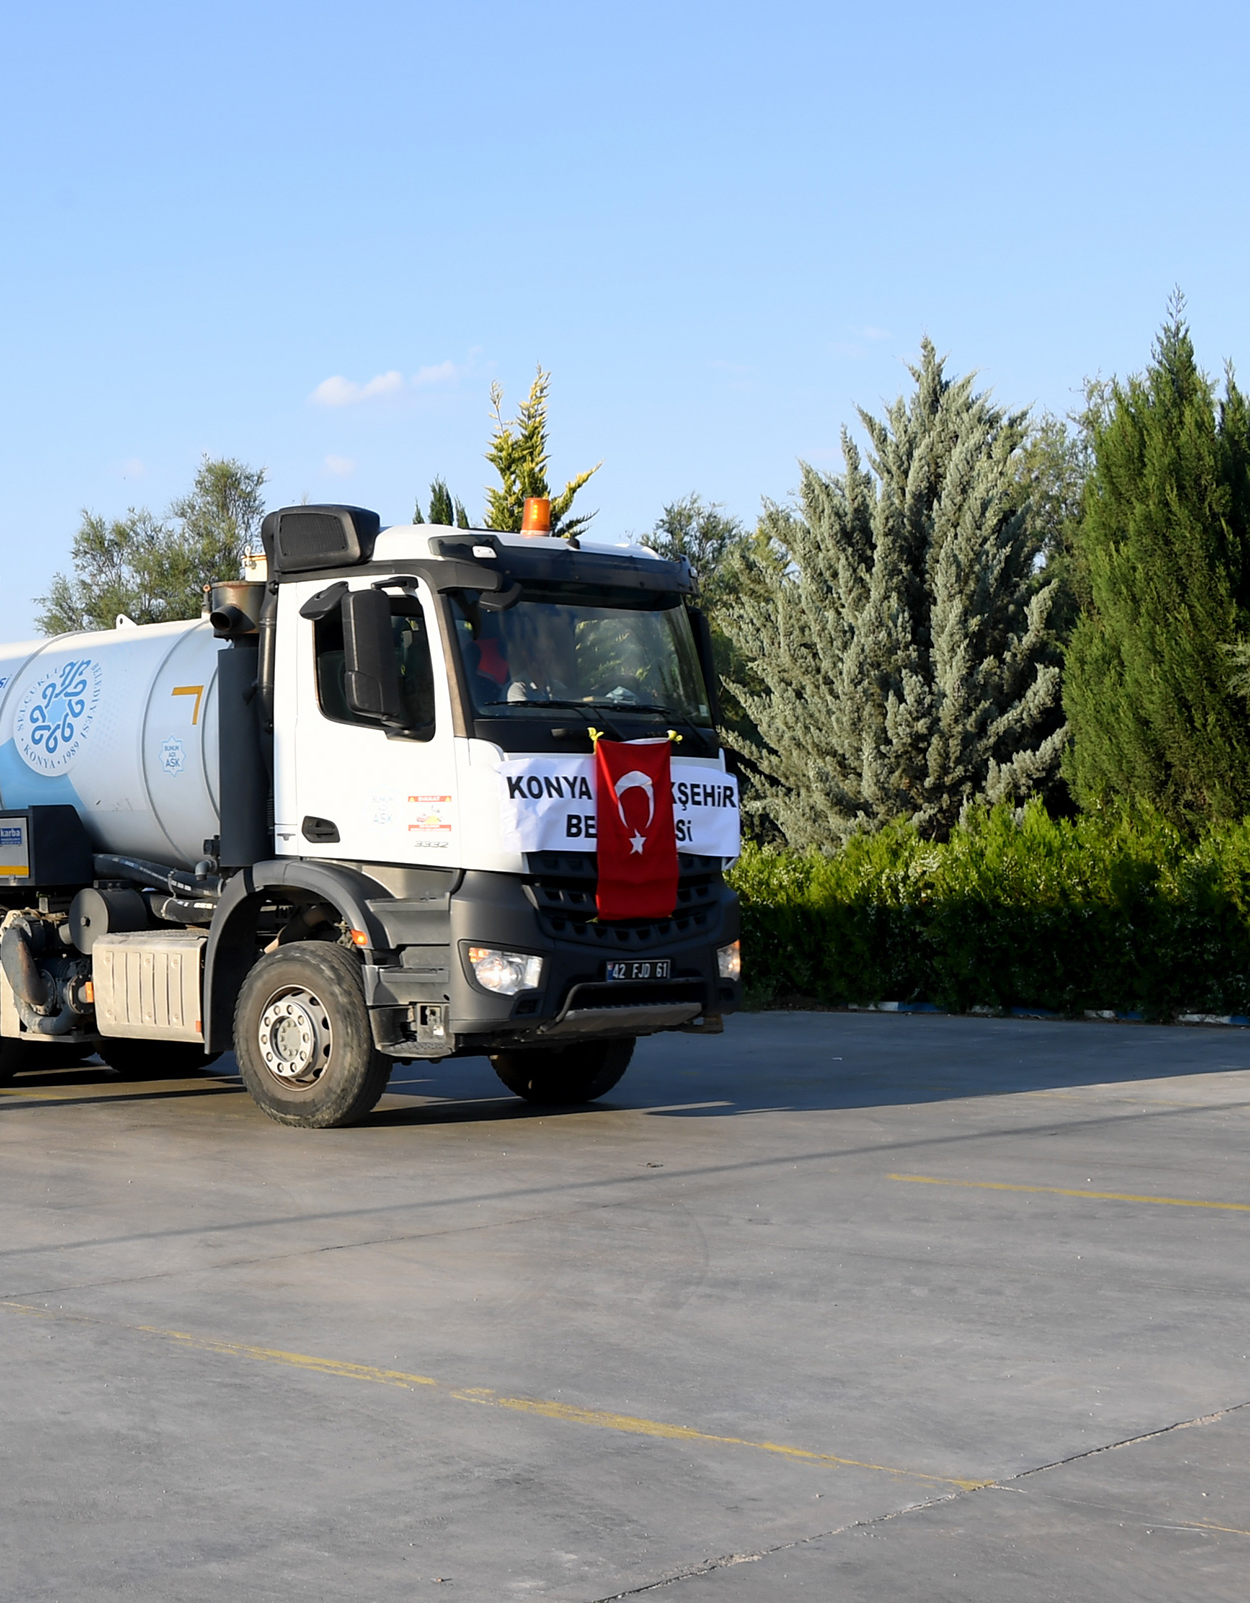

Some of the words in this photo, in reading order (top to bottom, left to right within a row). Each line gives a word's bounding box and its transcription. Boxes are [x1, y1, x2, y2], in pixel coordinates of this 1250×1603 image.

[23, 743, 56, 770] KONYA
[62, 740, 80, 765] 1989
[507, 775, 592, 800] KONYA
[0, 828, 21, 837] karba
[612, 963, 626, 979] 42
[631, 963, 651, 979] FJD
[656, 962, 668, 978] 61
